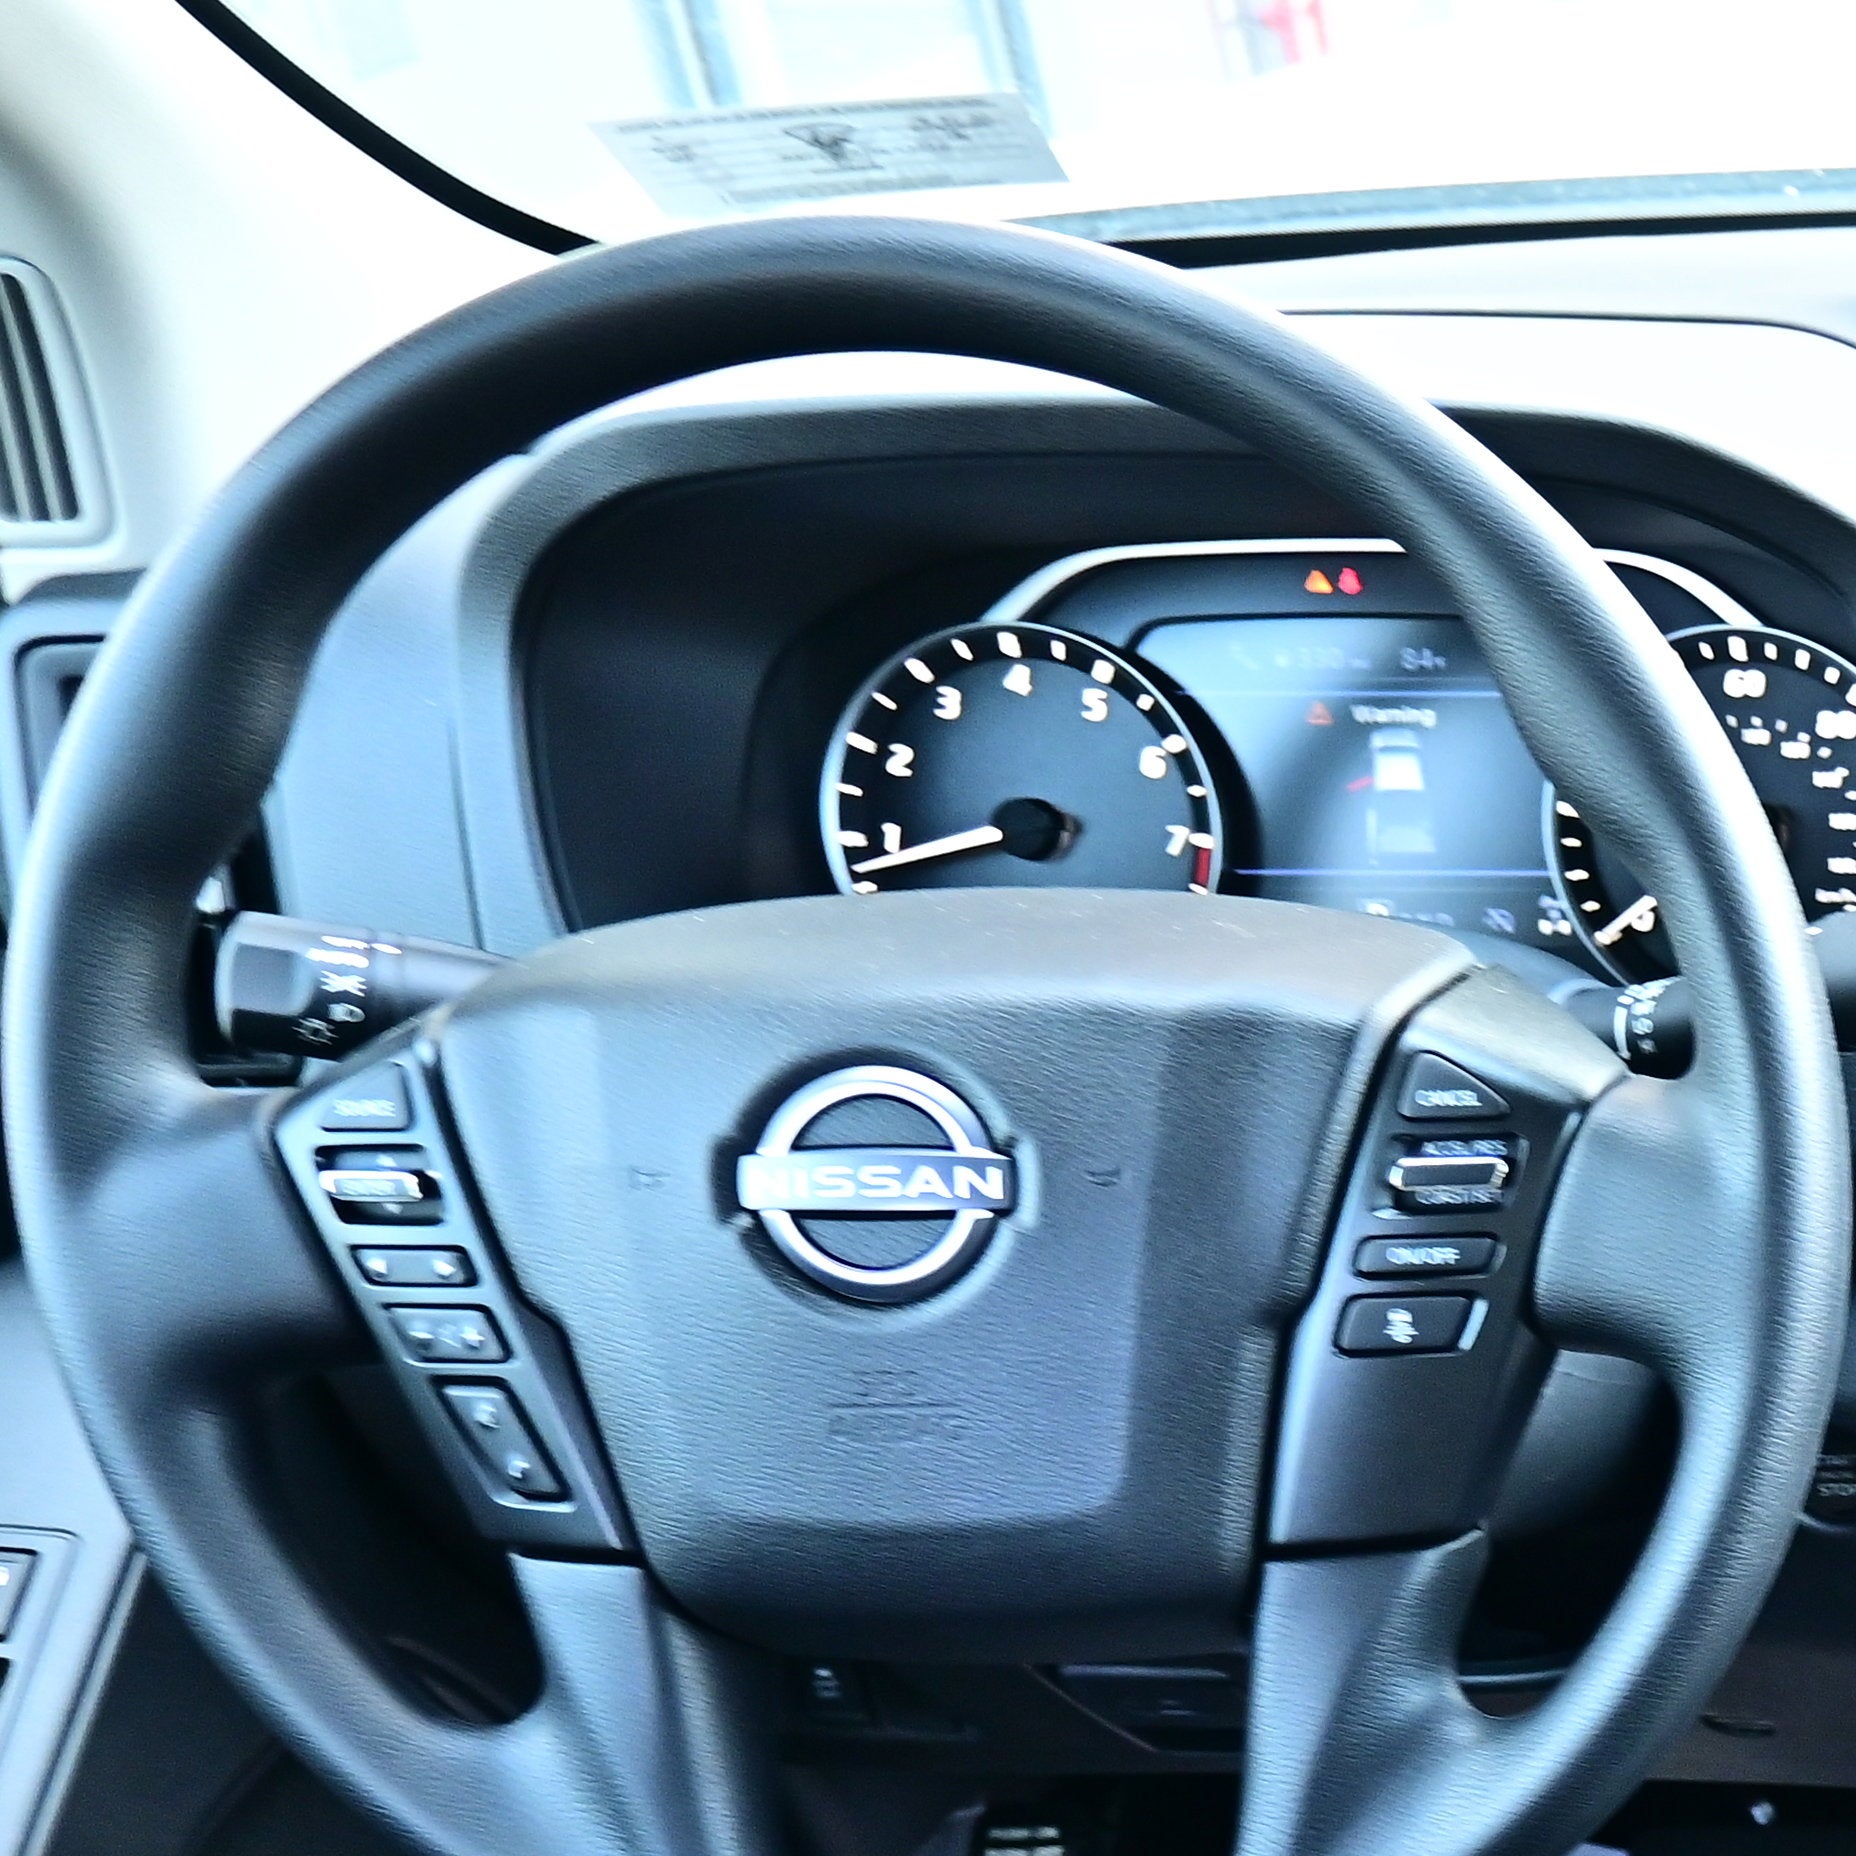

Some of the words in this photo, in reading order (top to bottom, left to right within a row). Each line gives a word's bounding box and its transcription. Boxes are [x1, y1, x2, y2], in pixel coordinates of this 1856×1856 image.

[932, 685, 962, 720] 3
[1080, 687, 1108, 722] 5
[884, 742, 915, 777] 2
[1138, 744, 1168, 780] 6
[1164, 824, 1191, 857] 7
[750, 1164, 1005, 1200] NISSAN
